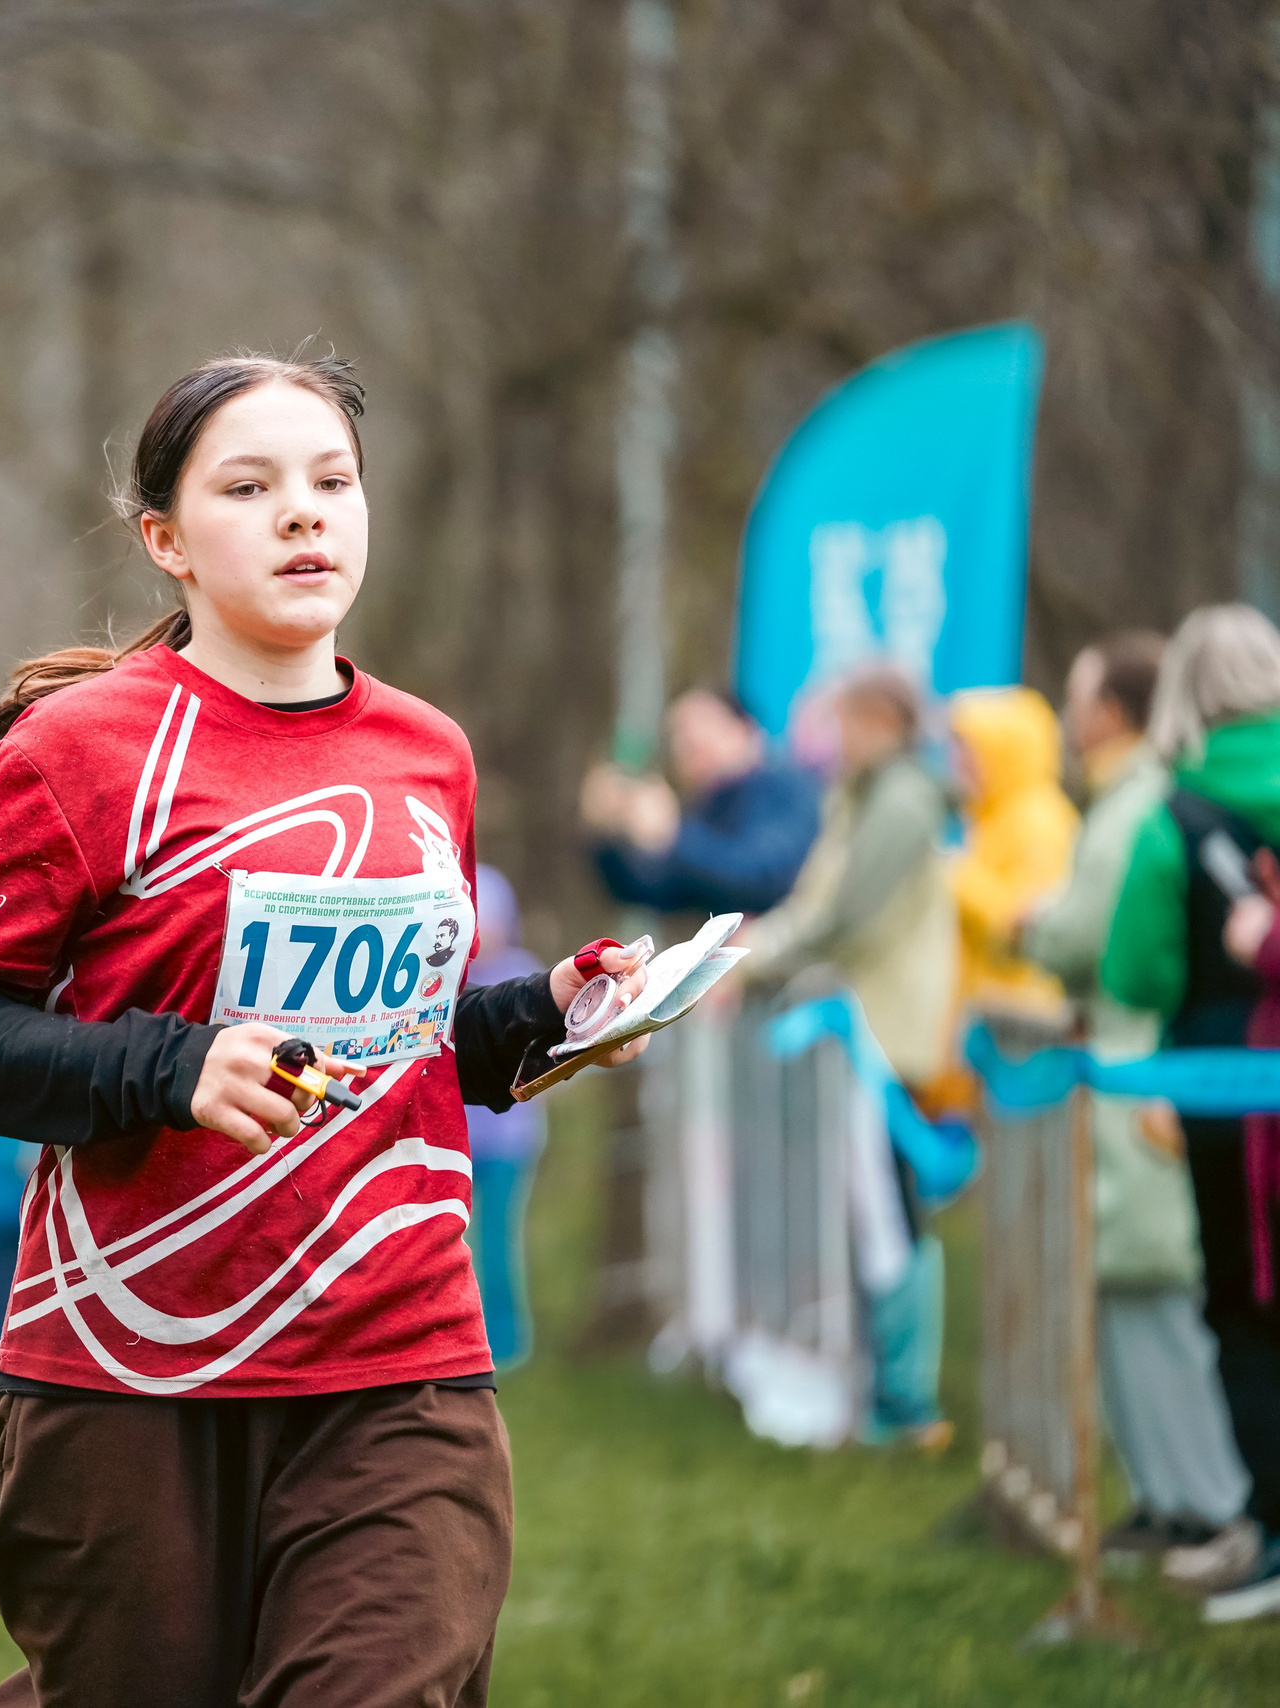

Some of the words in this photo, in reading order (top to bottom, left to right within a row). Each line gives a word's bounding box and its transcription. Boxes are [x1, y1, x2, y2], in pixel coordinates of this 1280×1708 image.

[244, 889, 317, 903] ВСЕРОССИЙСКИЕ
[320, 895, 376, 906] СПОРТИВНЫЕ
[378, 891, 431, 906] СОРЕВНОВАНИЯ
[264, 904, 276, 913] ПО
[278, 905, 341, 917] СПОРТИВНОМУ
[342, 906, 415, 918] ОРИЕНТИРОВАНИЮ
[238, 920, 423, 1014] 1706
[223, 1007, 260, 1021] Памяти
[263, 1014, 306, 1024] военного
[309, 1015, 357, 1026] топографа
[360, 1014, 368, 1024] А.
[370, 1014, 378, 1023] В.
[380, 1007, 417, 1021] Пастухова
[326, 1025, 367, 1035] Пятигорск
